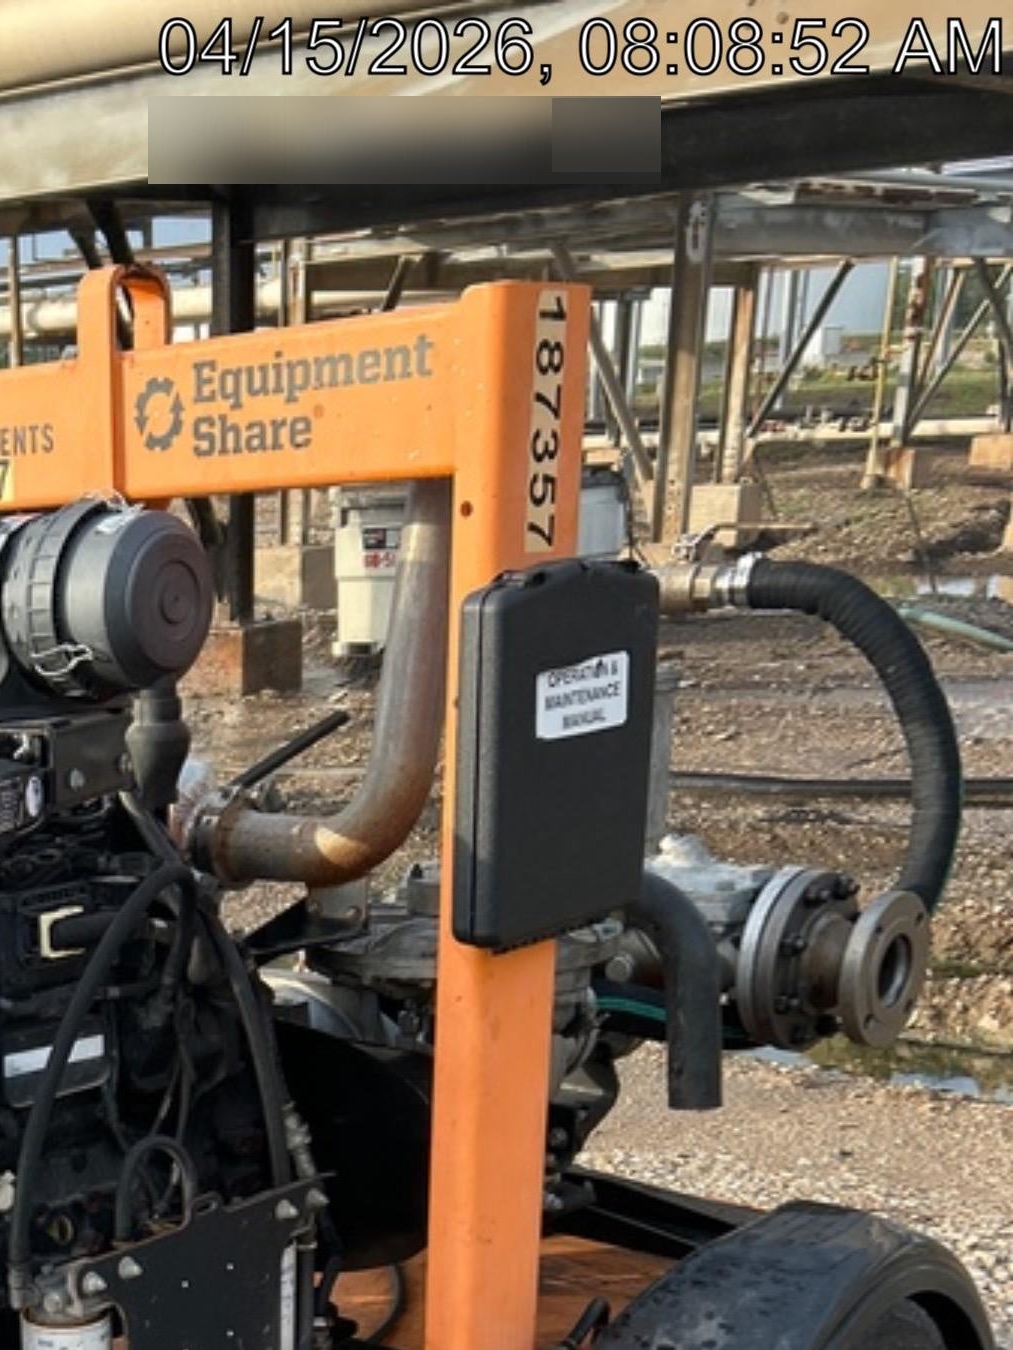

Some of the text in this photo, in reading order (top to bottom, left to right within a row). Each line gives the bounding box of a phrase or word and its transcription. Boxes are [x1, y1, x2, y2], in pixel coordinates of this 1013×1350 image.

[192, 333, 435, 410] Equipment
[527, 296, 567, 547] 187357
[544, 681, 622, 711] MAINTENANCE
[562, 707, 607, 730] MANUAL
